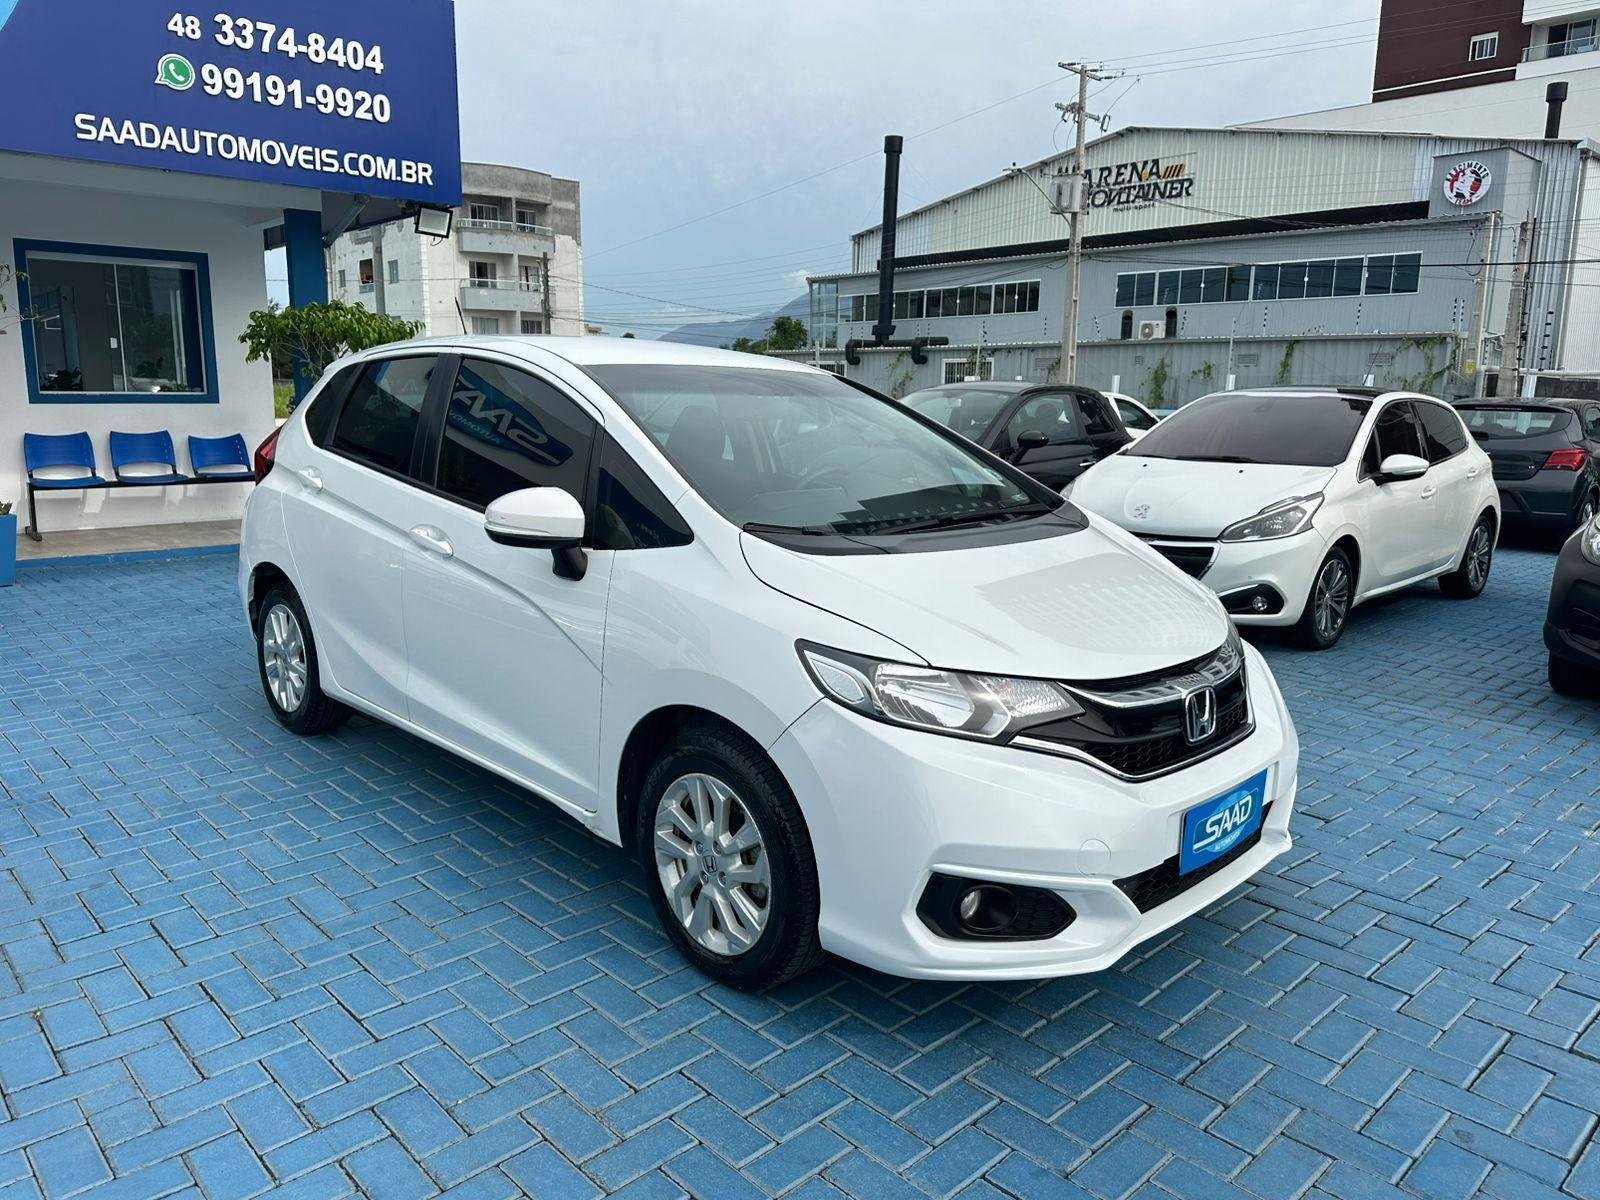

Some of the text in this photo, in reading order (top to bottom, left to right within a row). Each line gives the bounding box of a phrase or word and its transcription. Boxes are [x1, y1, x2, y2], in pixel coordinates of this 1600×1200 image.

[167, 13, 385, 76] 48 3374-8404
[201, 63, 391, 124] 99191-9920
[74, 113, 434, 187] SAADAUTOMOVEIS.COM.BR
[1083, 159, 1162, 189] ARENA
[1087, 177, 1194, 209] ONTAINER
[1193, 795, 1252, 853] SAAD
